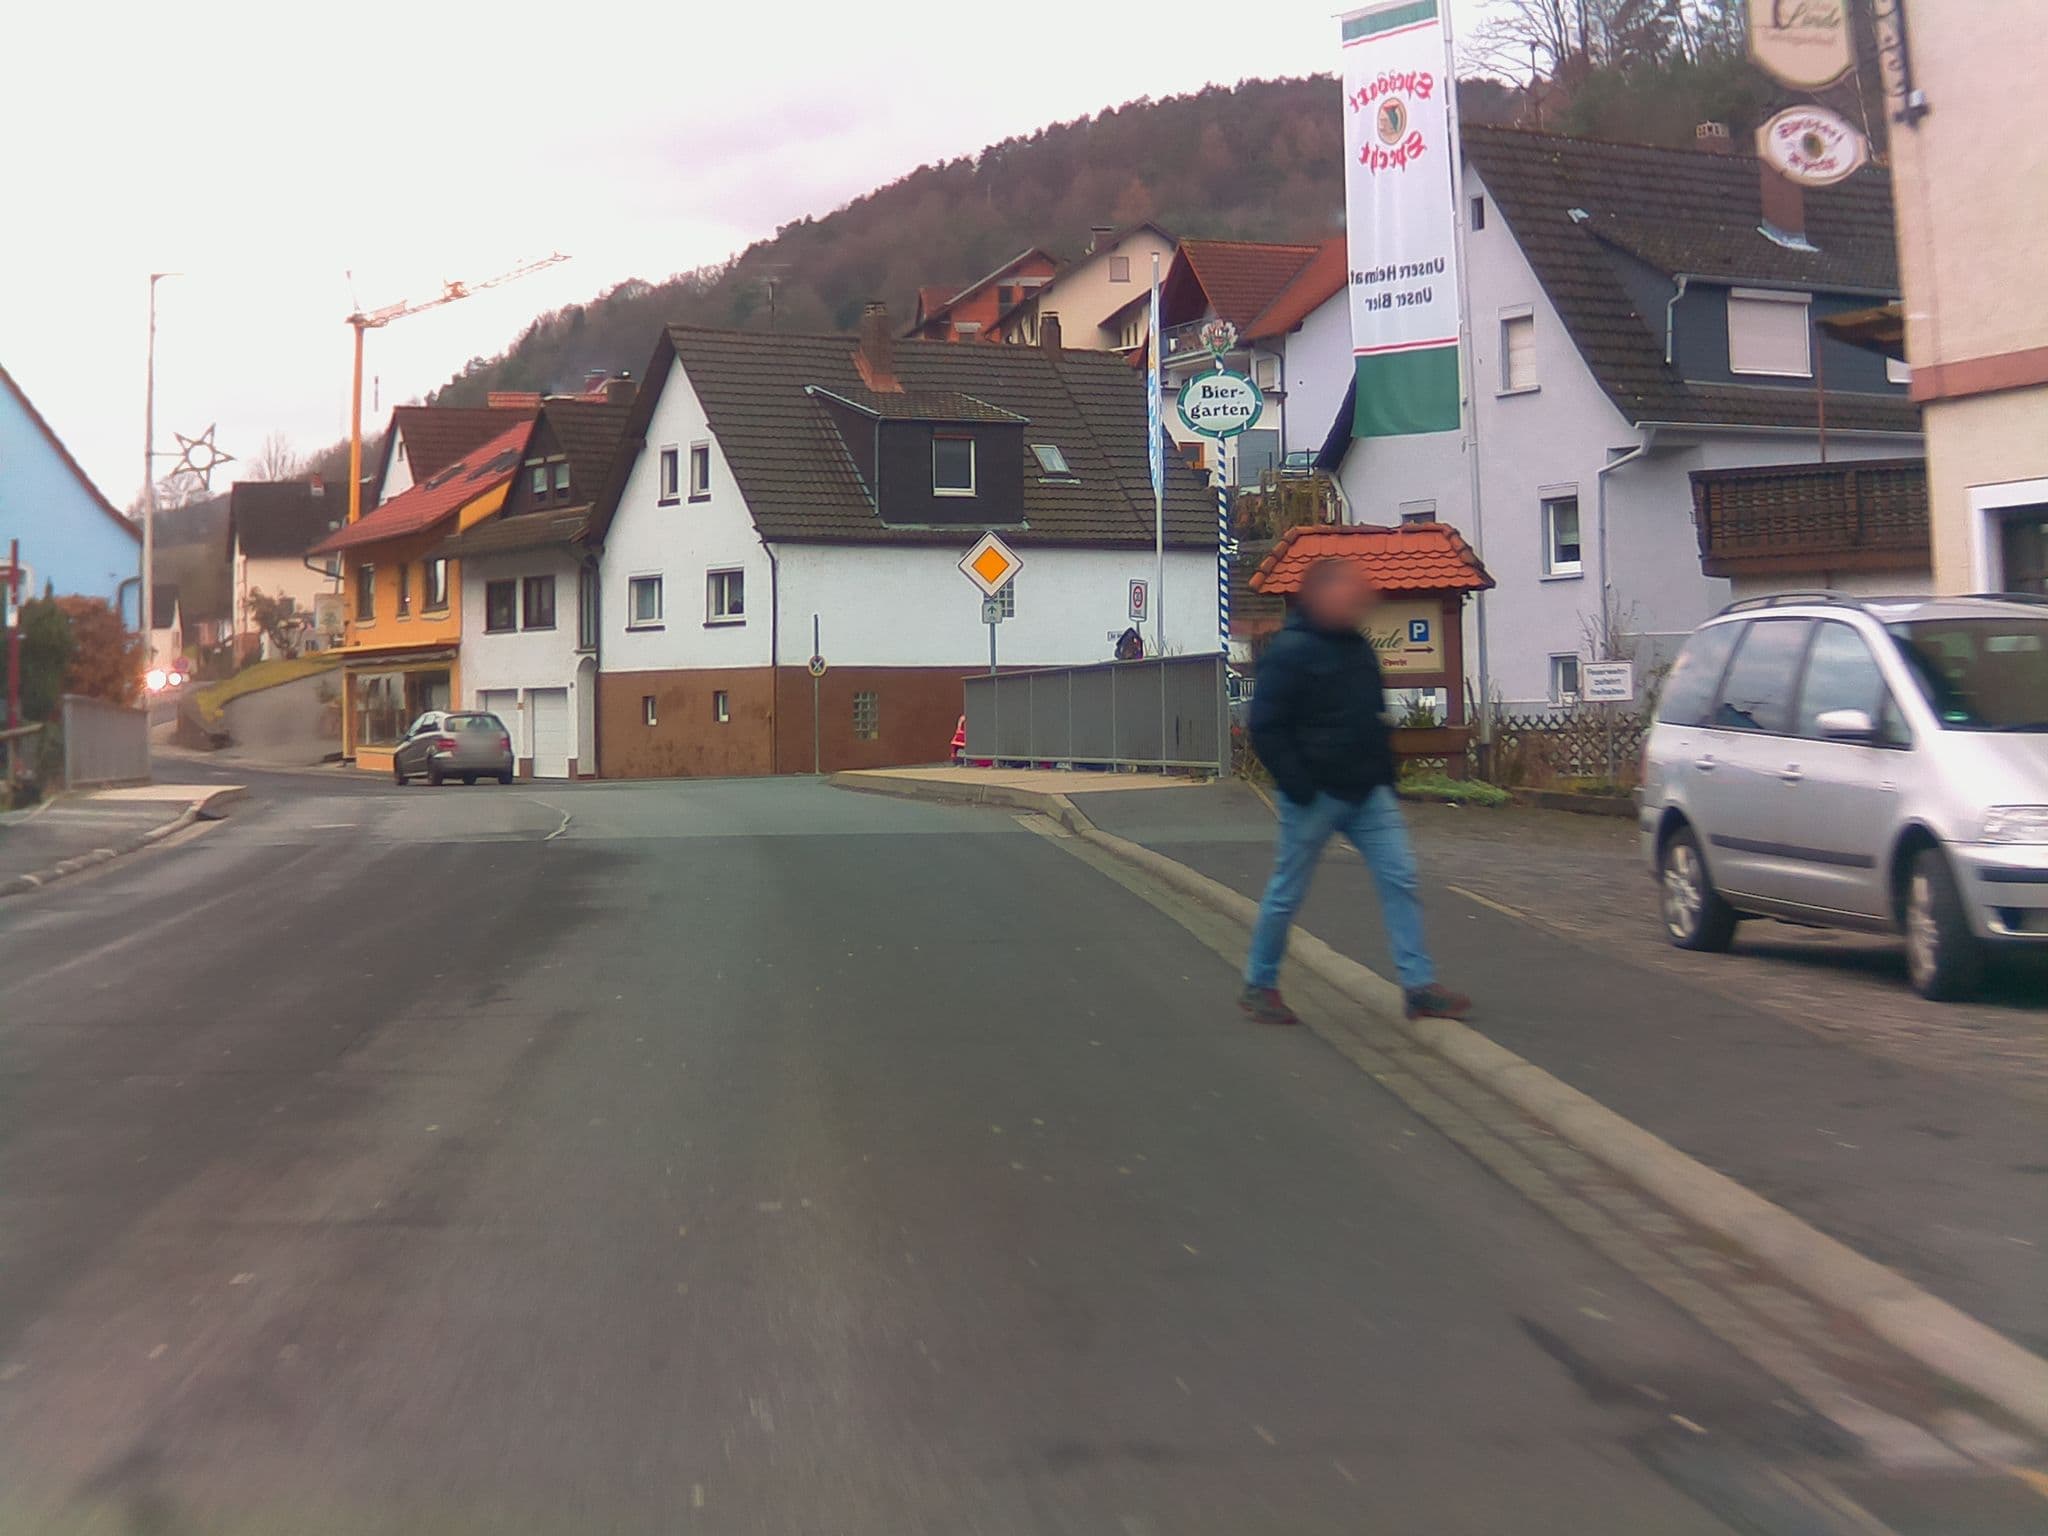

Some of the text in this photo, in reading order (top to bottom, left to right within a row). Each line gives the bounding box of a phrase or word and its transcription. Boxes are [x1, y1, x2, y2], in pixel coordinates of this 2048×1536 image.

[1201, 384, 1246, 399] Bier-
[1190, 404, 1250, 420] garten
[1412, 622, 1427, 640] P
